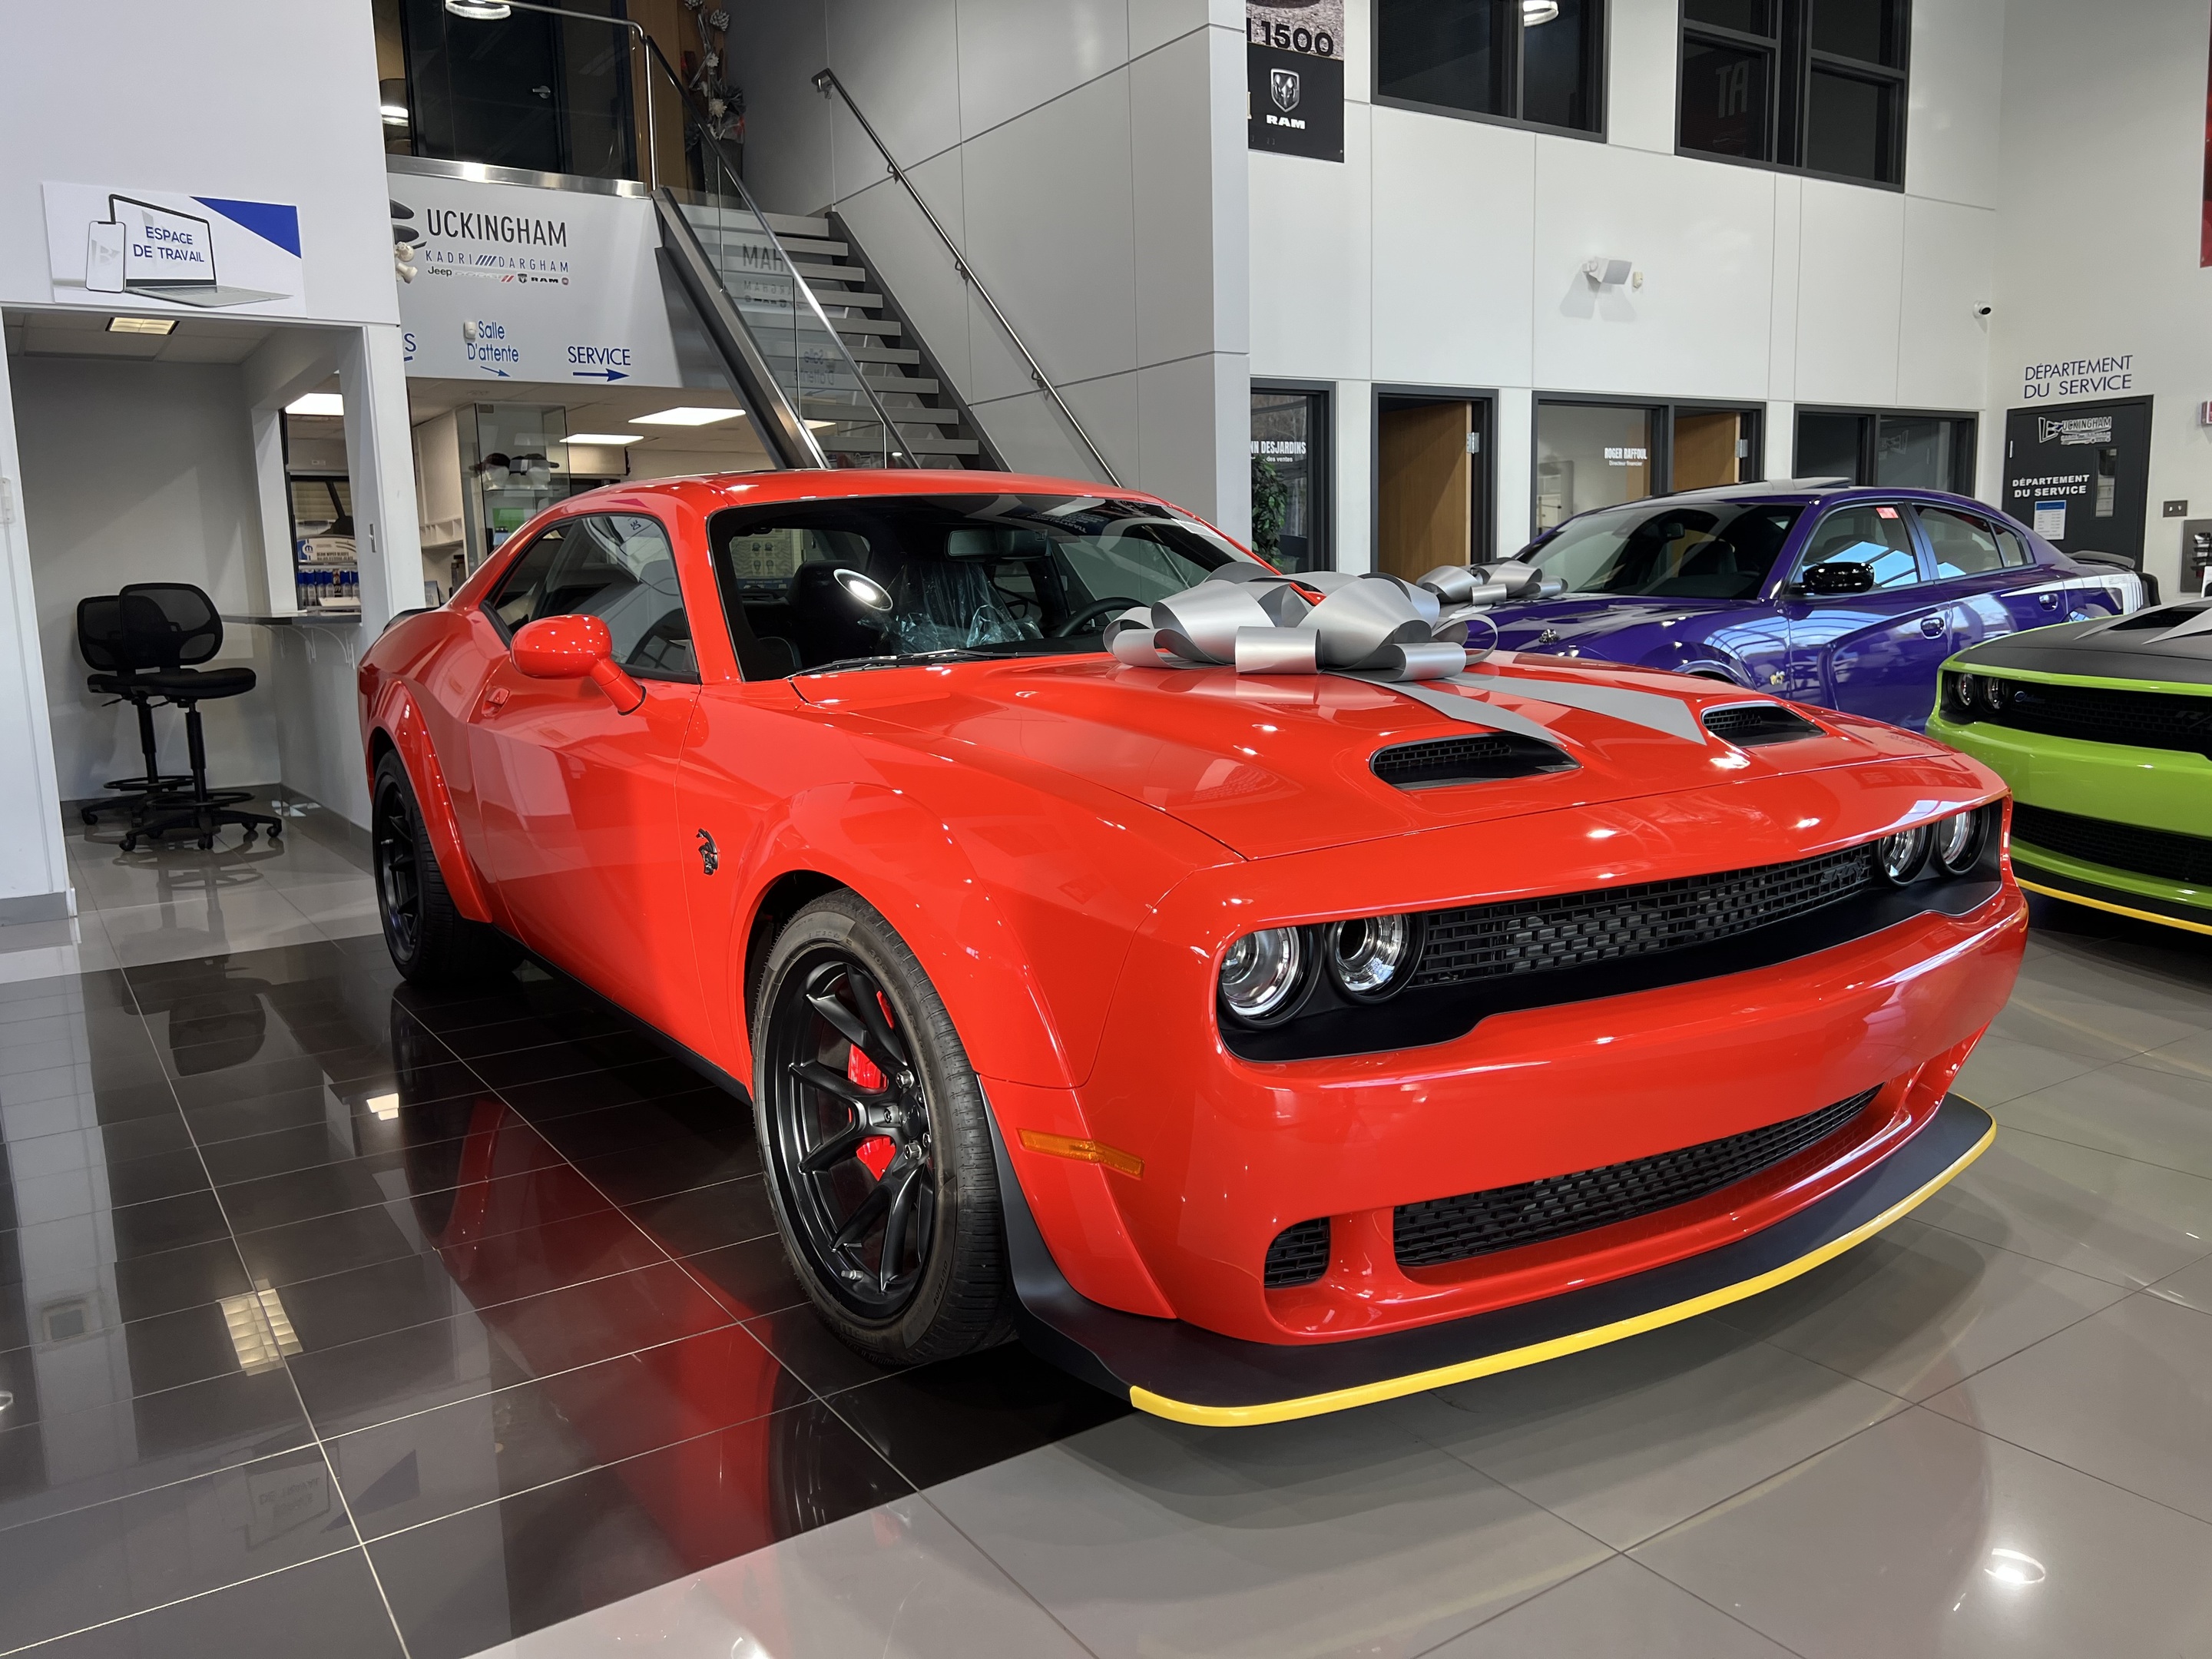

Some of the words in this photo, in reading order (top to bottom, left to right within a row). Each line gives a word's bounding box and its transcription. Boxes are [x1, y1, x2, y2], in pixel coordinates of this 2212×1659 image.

[1267, 114, 1306, 130] RAM
[144, 226, 194, 245] ESPACE
[427, 208, 568, 247] UCKINGHAM
[133, 244, 153, 258] DE
[157, 247, 205, 263] TRAVAIL
[426, 250, 472, 264] KADRI
[498, 256, 569, 273] DARGHAM
[427, 266, 452, 277] Jeep
[478, 320, 505, 339] Salle
[466, 343, 520, 363] D'attente
[567, 346, 631, 366] SERVICE
[2025, 354, 2134, 381] DÉPARTEMENT
[2024, 382, 2050, 399] DU
[2058, 374, 2132, 396] SERVICE
[1260, 441, 1306, 454] DESJARDINS
[1604, 447, 1623, 459] ROGER
[1623, 447, 1648, 460] RAFFOUL
[2012, 474, 2090, 487] DÉPARTEMENT
[2014, 488, 2031, 498] DU
[2034, 485, 2087, 496] SERVICE
